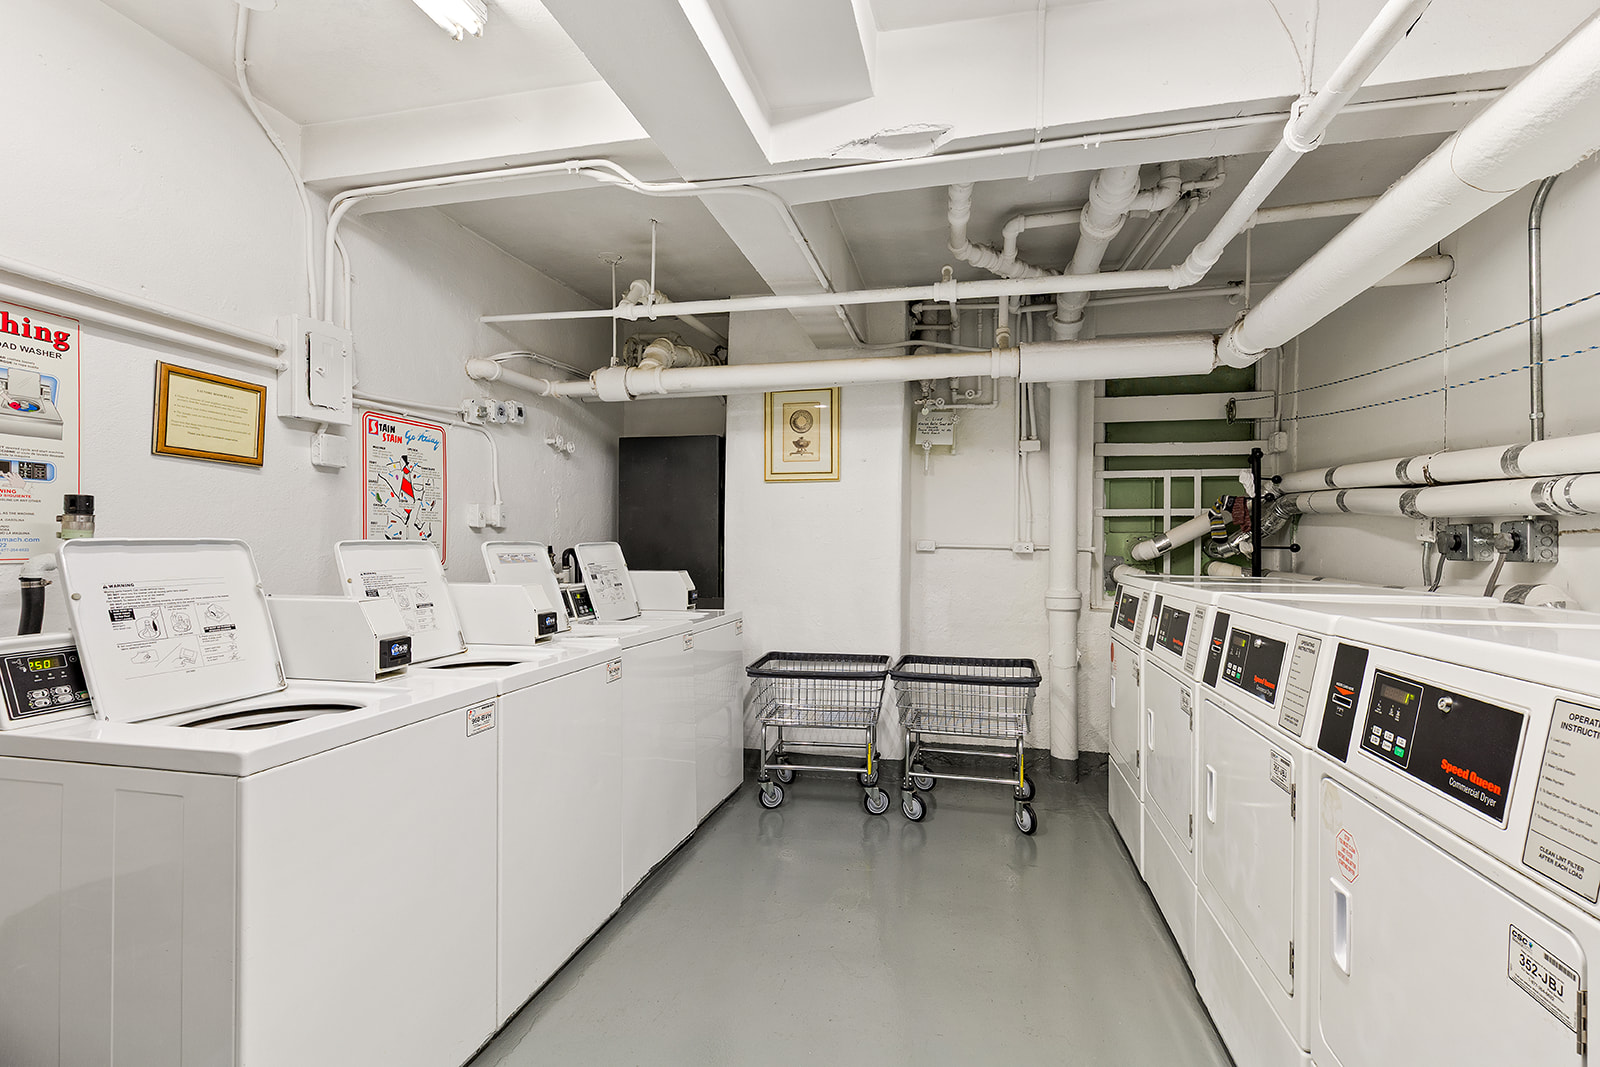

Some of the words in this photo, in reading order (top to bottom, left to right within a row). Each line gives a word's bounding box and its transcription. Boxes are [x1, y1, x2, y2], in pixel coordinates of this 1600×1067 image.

[0, 341, 17, 350] AD
[20, 345, 62, 359] WASHER
[369, 419, 396, 434] STAIN
[382, 433, 403, 444] STAIN
[1440, 758, 1470, 780] Speed
[1469, 771, 1502, 796] Queen
[1449, 776, 1480, 799] Commercial
[1480, 791, 1497, 807] Dryer
[1538, 853, 1554, 865] AFTER
[1554, 860, 1568, 872] EACH
[1568, 868, 1583, 880] LOAD
[1539, 845, 1556, 858] CLEAN
[1555, 854, 1568, 864] LINT
[1567, 860, 1585, 873] FILTER
[1512, 929, 1528, 945] CSC
[1519, 953, 1564, 997] 352-JBJ
